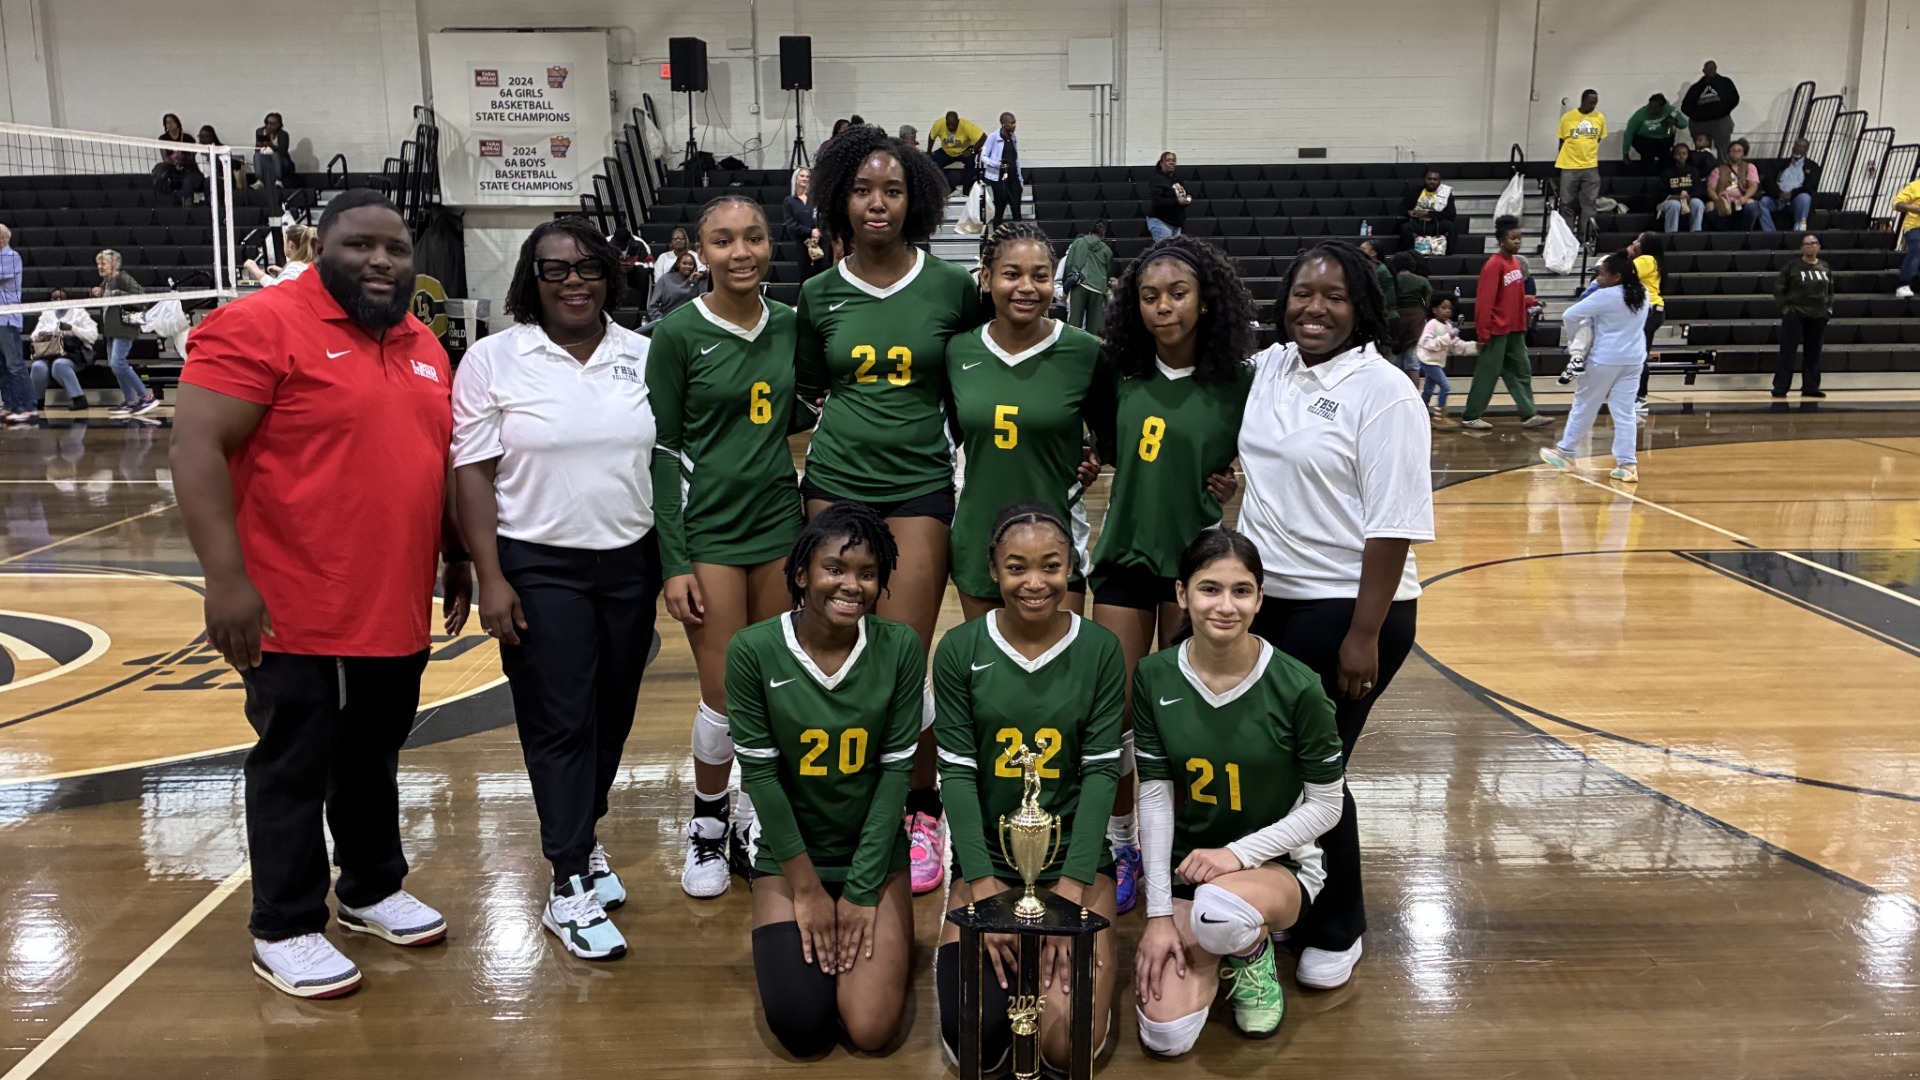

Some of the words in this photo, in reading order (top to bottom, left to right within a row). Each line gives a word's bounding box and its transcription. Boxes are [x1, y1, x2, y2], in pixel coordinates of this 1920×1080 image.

[508, 77, 534, 86] 2024
[499, 89, 513, 98] 6A
[515, 89, 544, 98] GIRLS
[491, 100, 554, 110] BASKETBALL
[475, 113, 505, 121] STATE
[507, 113, 570, 121] CHAMPIONS
[512, 147, 537, 156] 2024
[504, 158, 518, 167] 6A
[519, 158, 546, 167] BOYS
[495, 170, 557, 179] BASKETBALL
[479, 181, 510, 191] STATE
[511, 181, 573, 191] CHAMPIONS
[613, 365, 638, 378] FHSA
[851, 344, 912, 387] 23
[750, 381, 772, 425] 6
[994, 404, 1019, 450] 5
[1138, 415, 1166, 463] 8
[799, 727, 869, 776] 20
[994, 727, 1062, 779] 22
[1185, 757, 1242, 811] 21
[1006, 994, 1048, 1013] 2026
